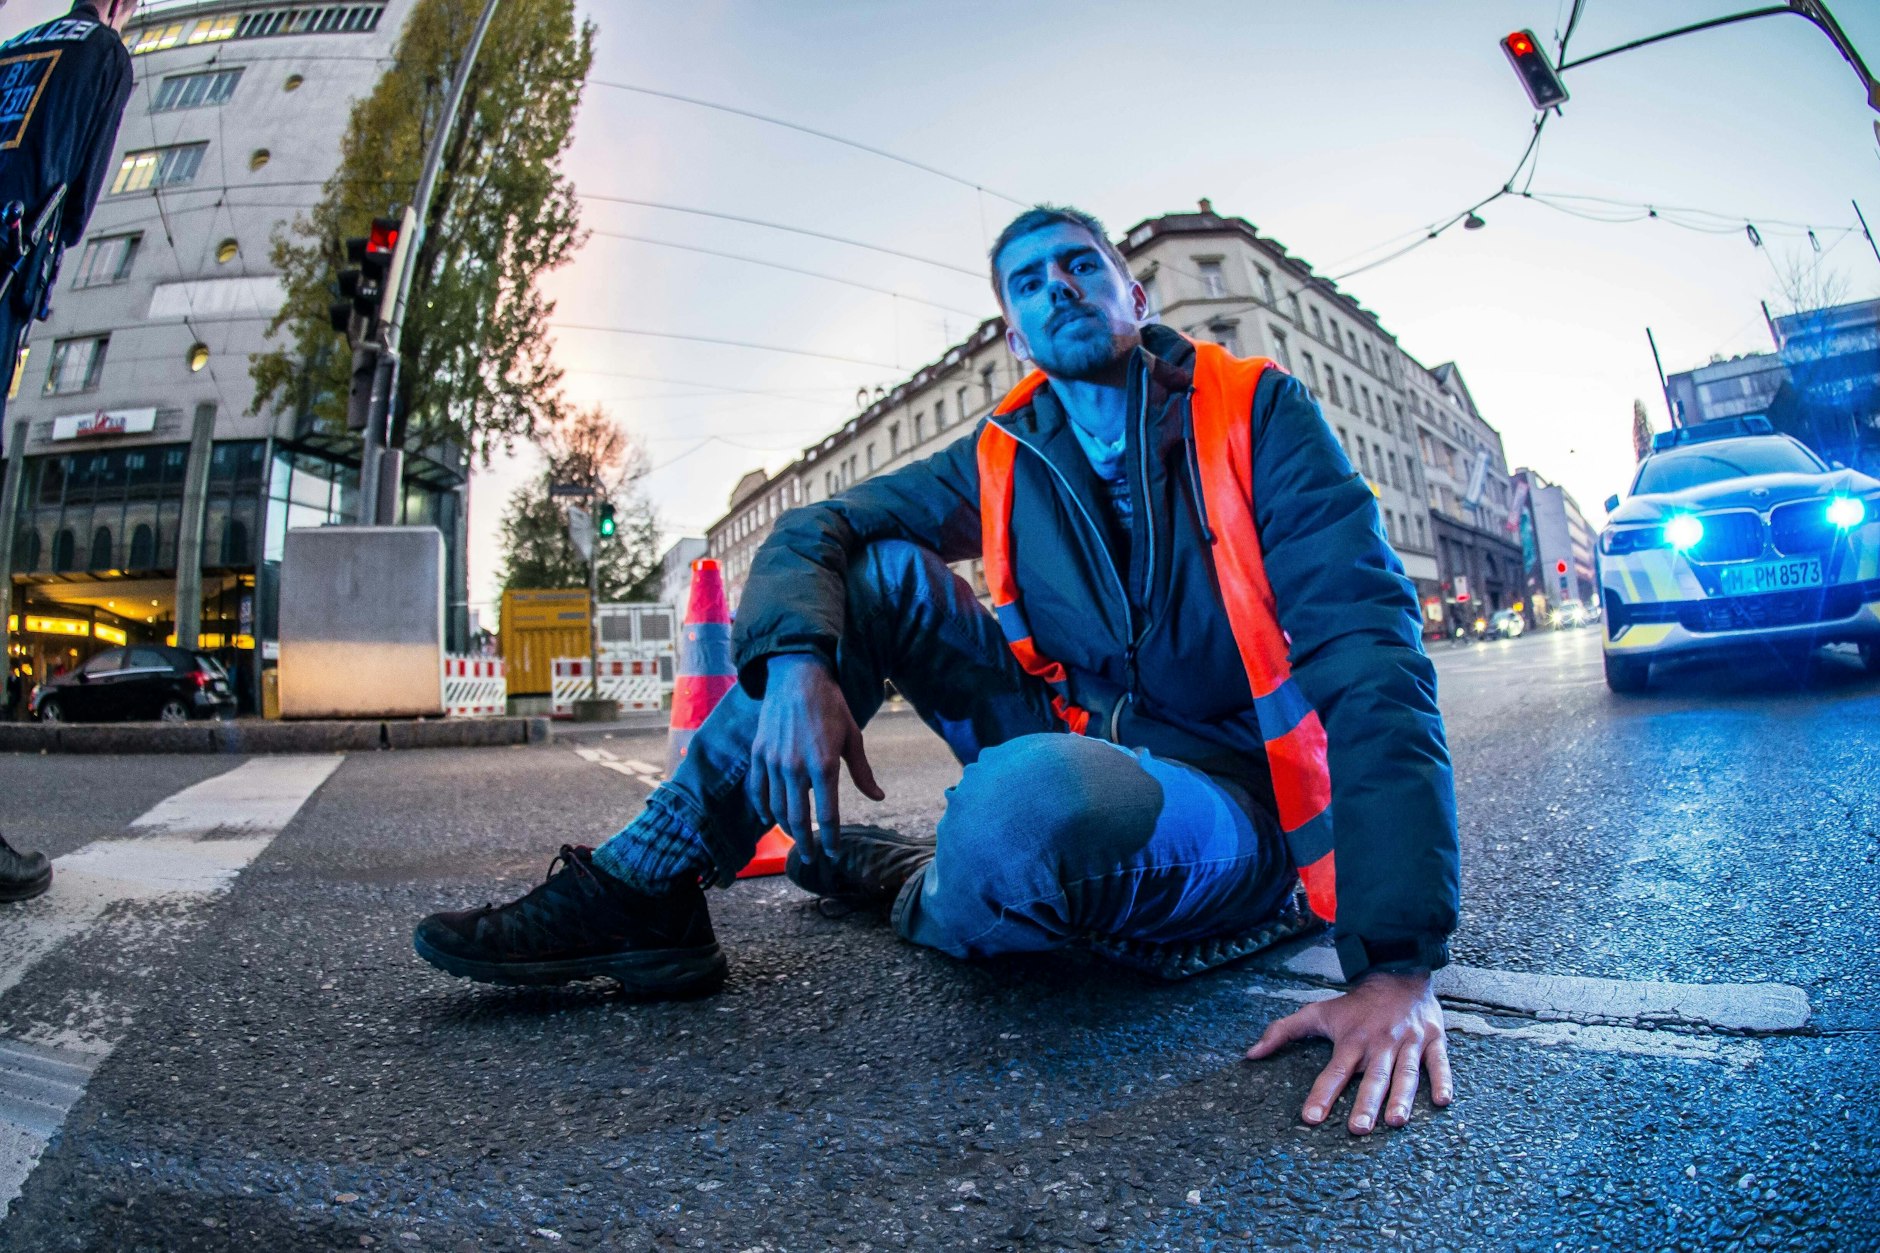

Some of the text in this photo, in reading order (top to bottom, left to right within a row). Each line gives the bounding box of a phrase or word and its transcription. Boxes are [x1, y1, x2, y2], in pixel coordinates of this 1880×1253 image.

[7, 20, 99, 48] OLIZEI
[2, 60, 38, 88] BY
[1755, 565, 1777, 588] PM
[1780, 561, 1820, 586] 8573
